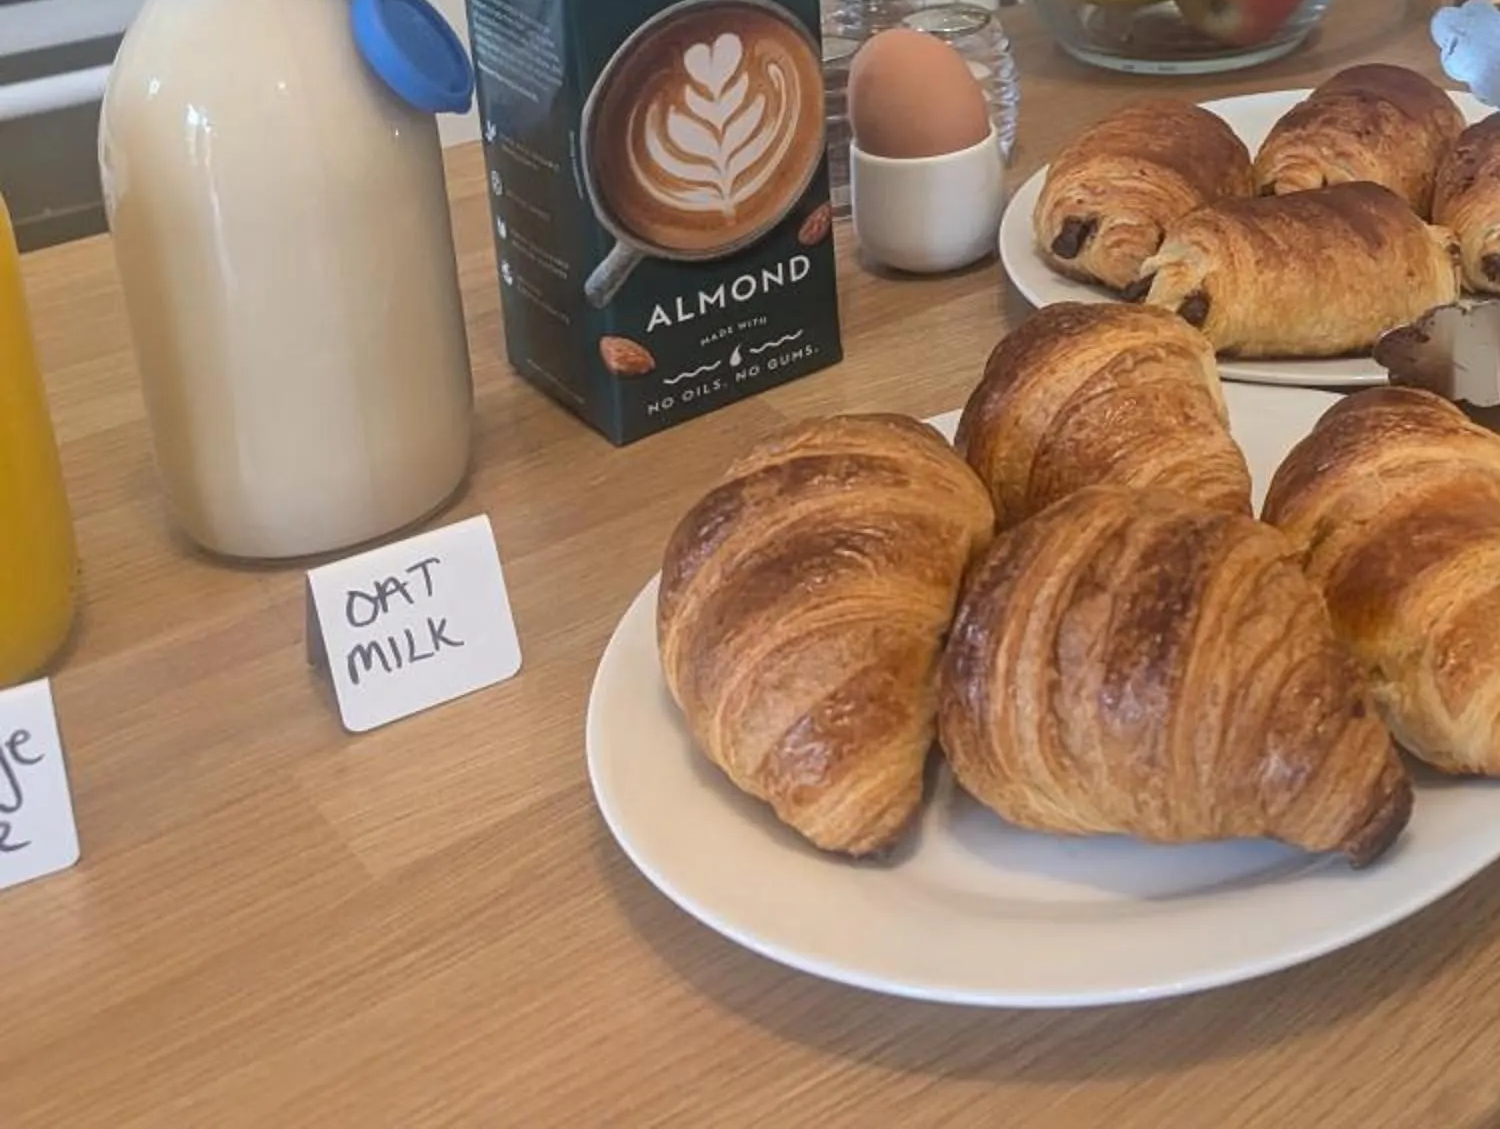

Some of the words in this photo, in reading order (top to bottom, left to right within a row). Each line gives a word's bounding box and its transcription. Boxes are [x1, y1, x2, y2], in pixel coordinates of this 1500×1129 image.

[645, 255, 811, 333] ALMOND
[700, 325, 733, 346] MADE
[738, 315, 767, 331] WITH
[647, 396, 674, 415] NO
[681, 379, 728, 402] OILS.
[734, 365, 760, 382] NO
[767, 344, 819, 370] GUMS.
[345, 557, 441, 628] OAT
[346, 617, 465, 686] MILK
